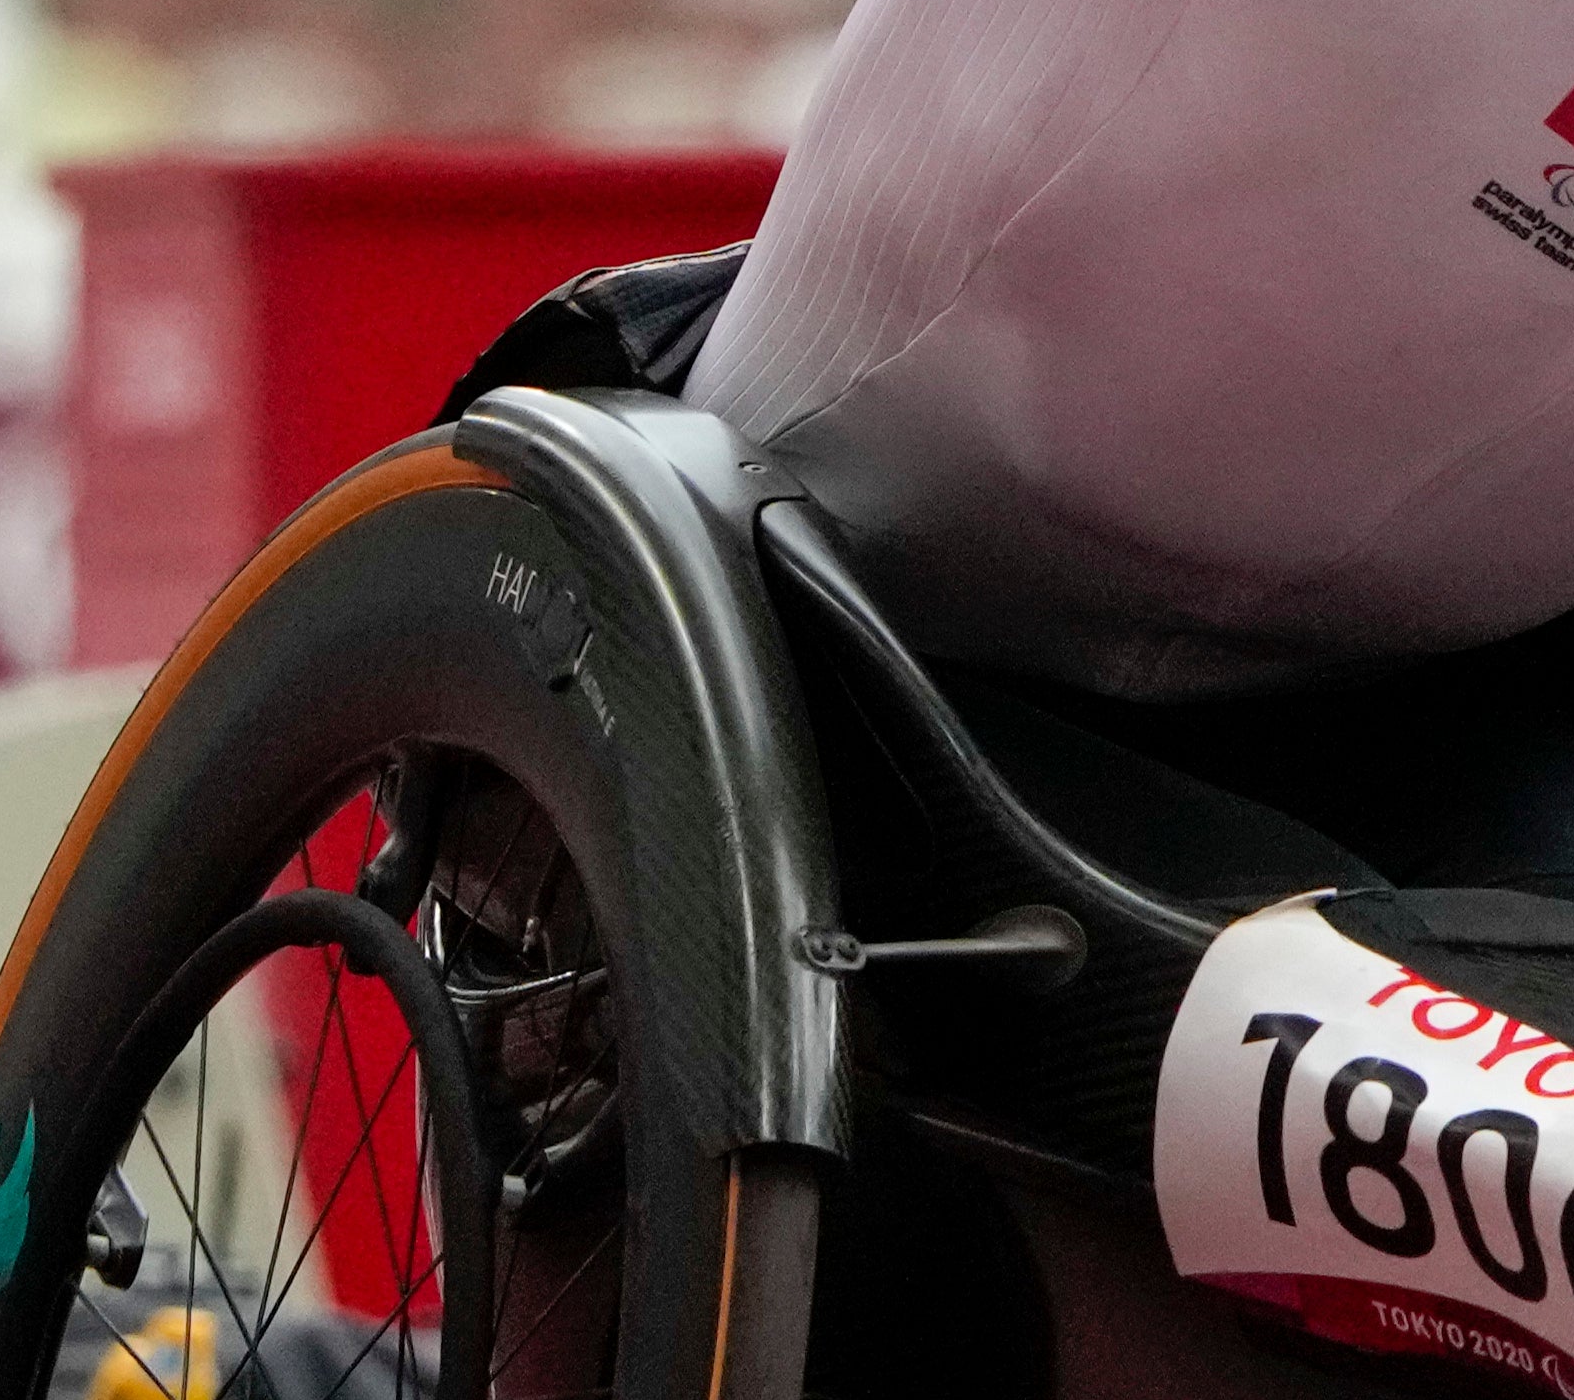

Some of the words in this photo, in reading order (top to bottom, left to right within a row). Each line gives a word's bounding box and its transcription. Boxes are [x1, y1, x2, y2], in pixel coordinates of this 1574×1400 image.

[1472, 195, 1533, 241] swiss
[1371, 1300, 1465, 1350] TOKYO
[1469, 1330, 1535, 1374] 2020
